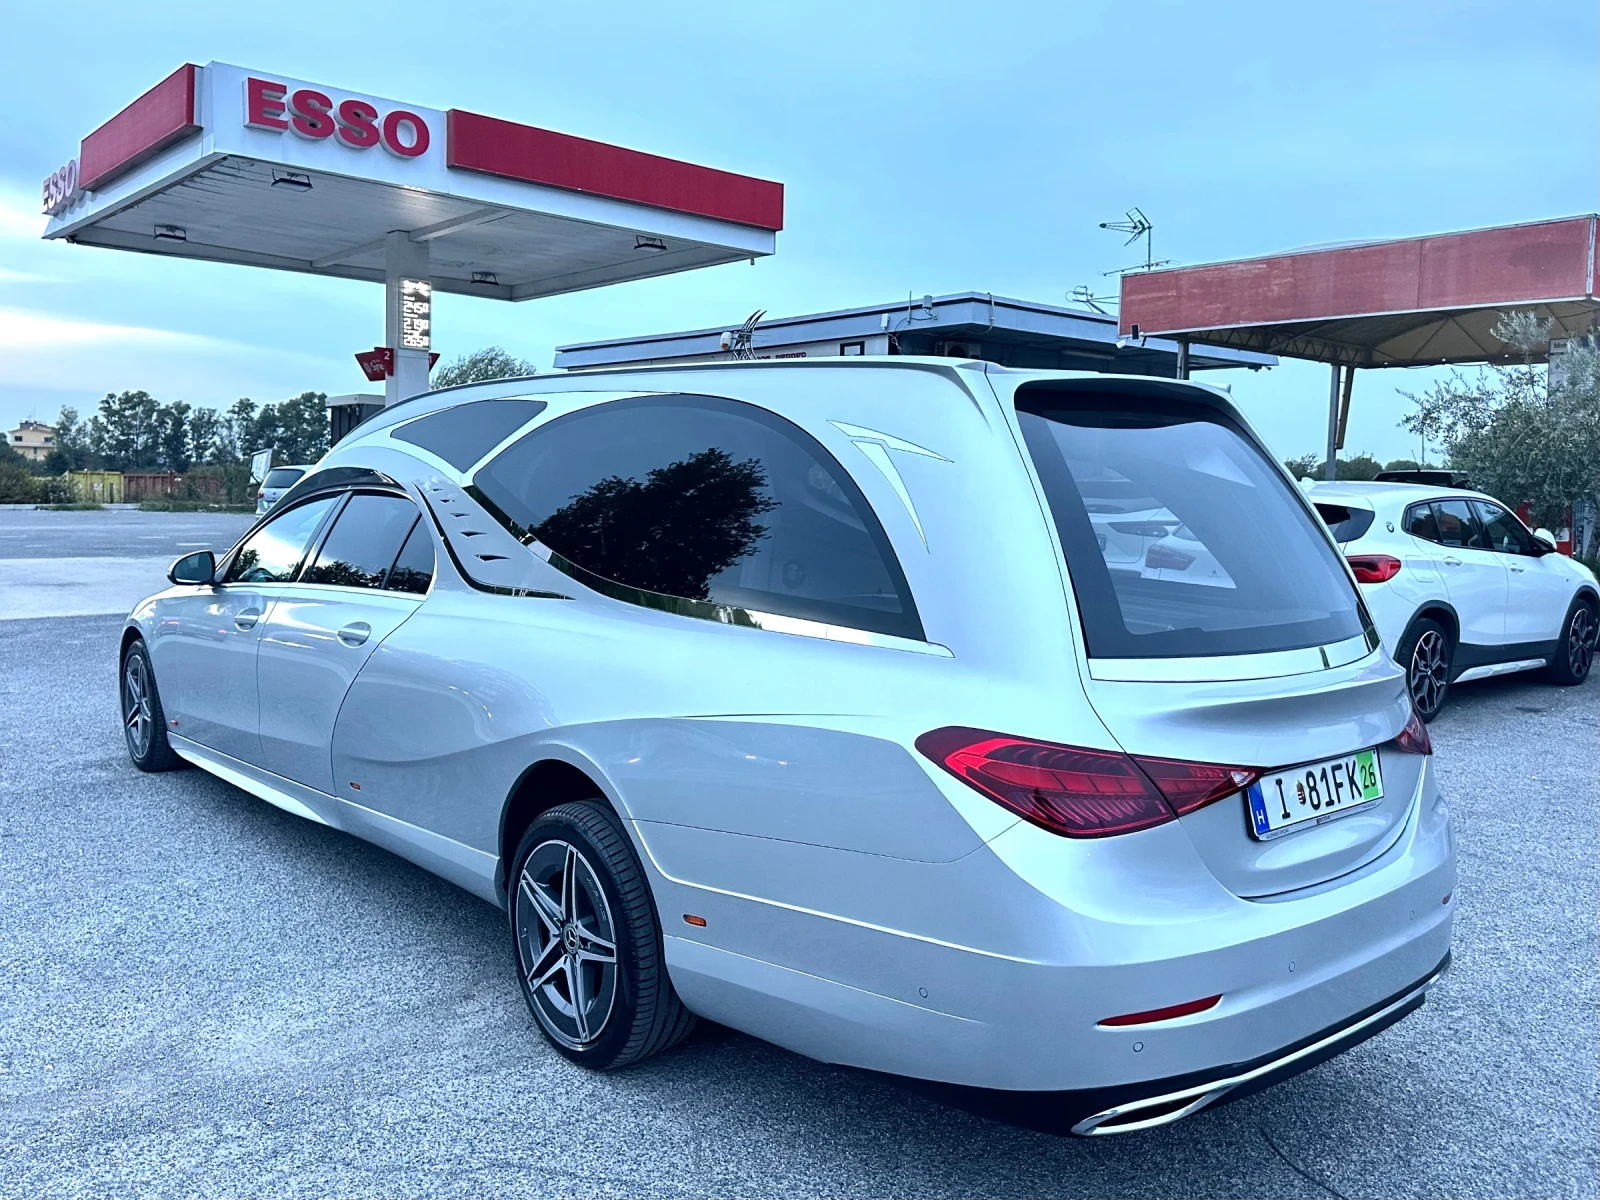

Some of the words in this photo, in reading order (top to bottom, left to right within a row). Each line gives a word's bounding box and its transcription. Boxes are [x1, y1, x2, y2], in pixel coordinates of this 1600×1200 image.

[244, 77, 430, 157] ESSO
[42, 160, 77, 215] ESSO
[384, 351, 391, 360] 2
[1256, 809, 1266, 825] H
